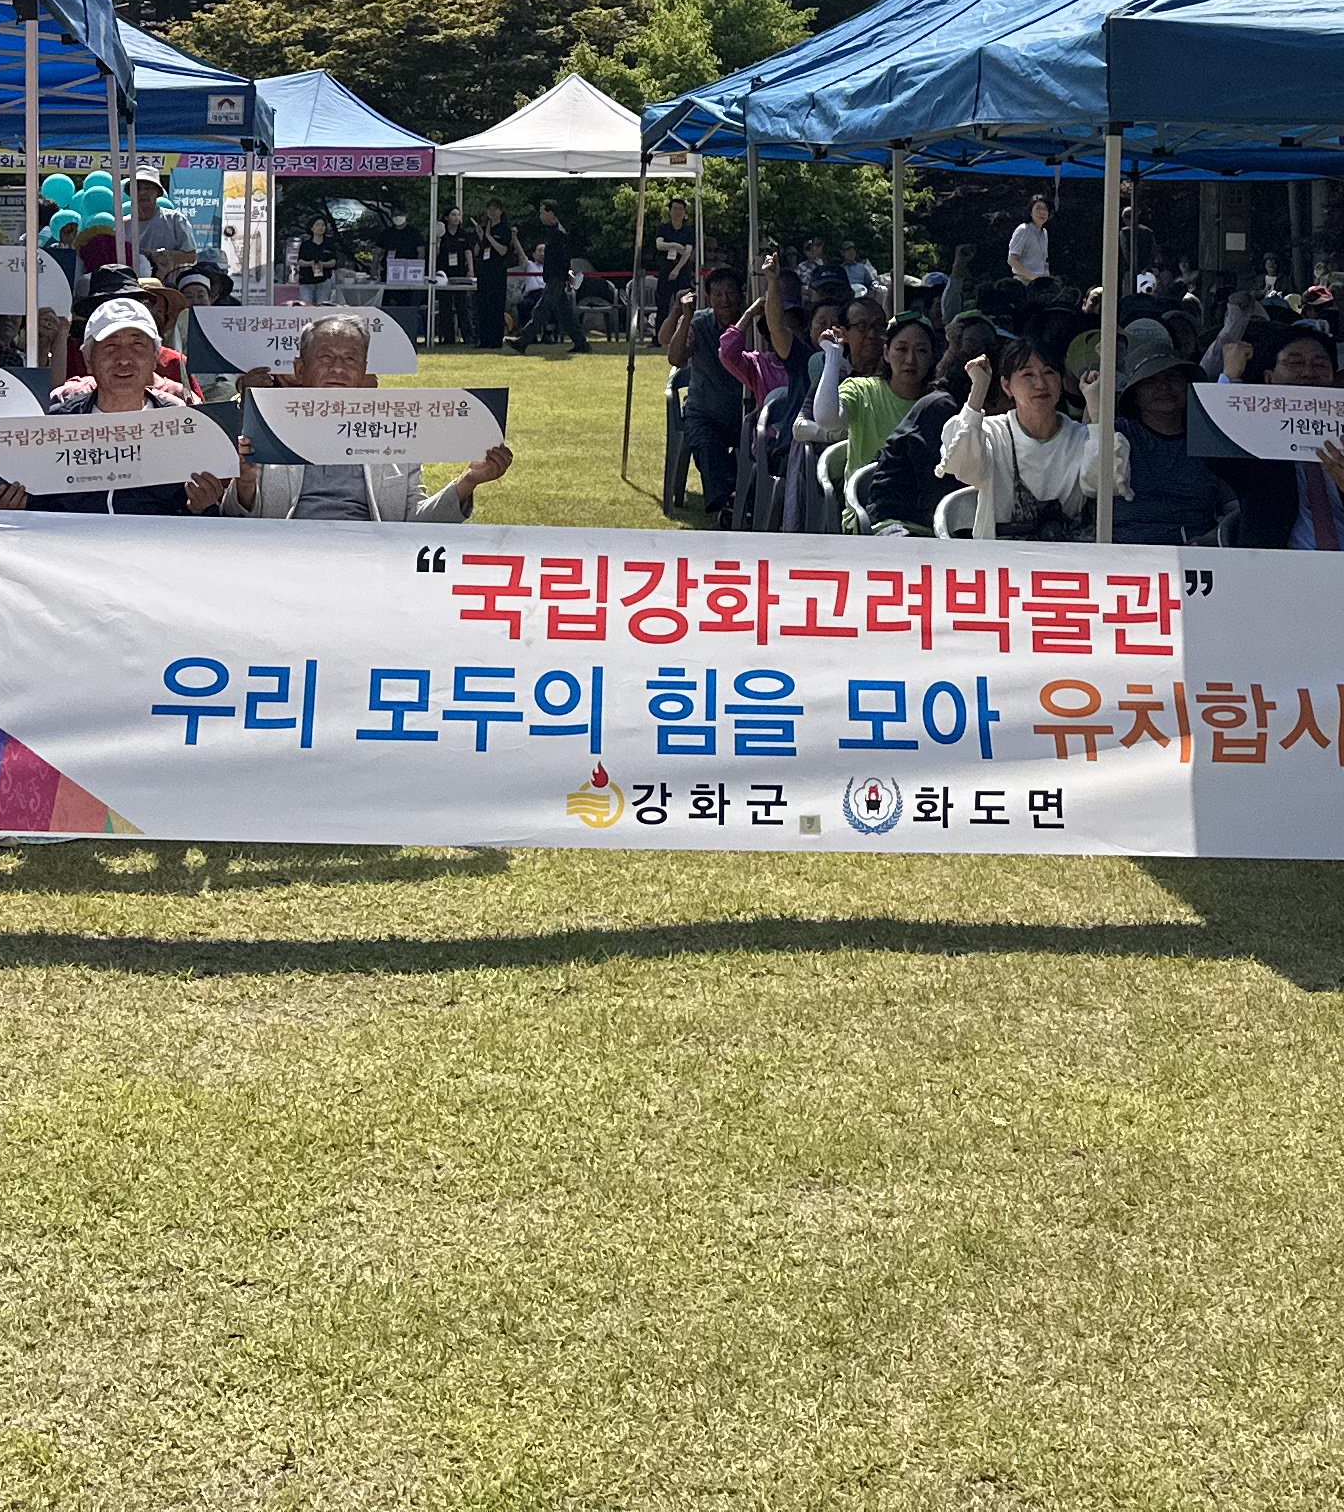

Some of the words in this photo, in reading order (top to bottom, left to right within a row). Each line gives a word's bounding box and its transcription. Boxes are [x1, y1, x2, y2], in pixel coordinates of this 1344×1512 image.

[190, 155, 220, 170] 강화
[324, 156, 353, 172] 지정
[359, 156, 421, 172] 서명운동
[7, 258, 47, 274] 건을
[221, 317, 312, 333] 국립강화고려
[285, 400, 422, 417] 국립강화고려박물관
[427, 401, 471, 417] 건립을
[149, 417, 197, 437] 건립을
[337, 421, 418, 438] 기원합니다!
[56, 445, 141, 466] 기원합니다!
[151, 657, 318, 749] 우리
[356, 665, 603, 755] 모두의
[646, 667, 804, 756] 힘을
[838, 676, 1001, 759] 모아
[631, 783, 788, 826] 강화군
[912, 786, 1066, 829] 화도면
